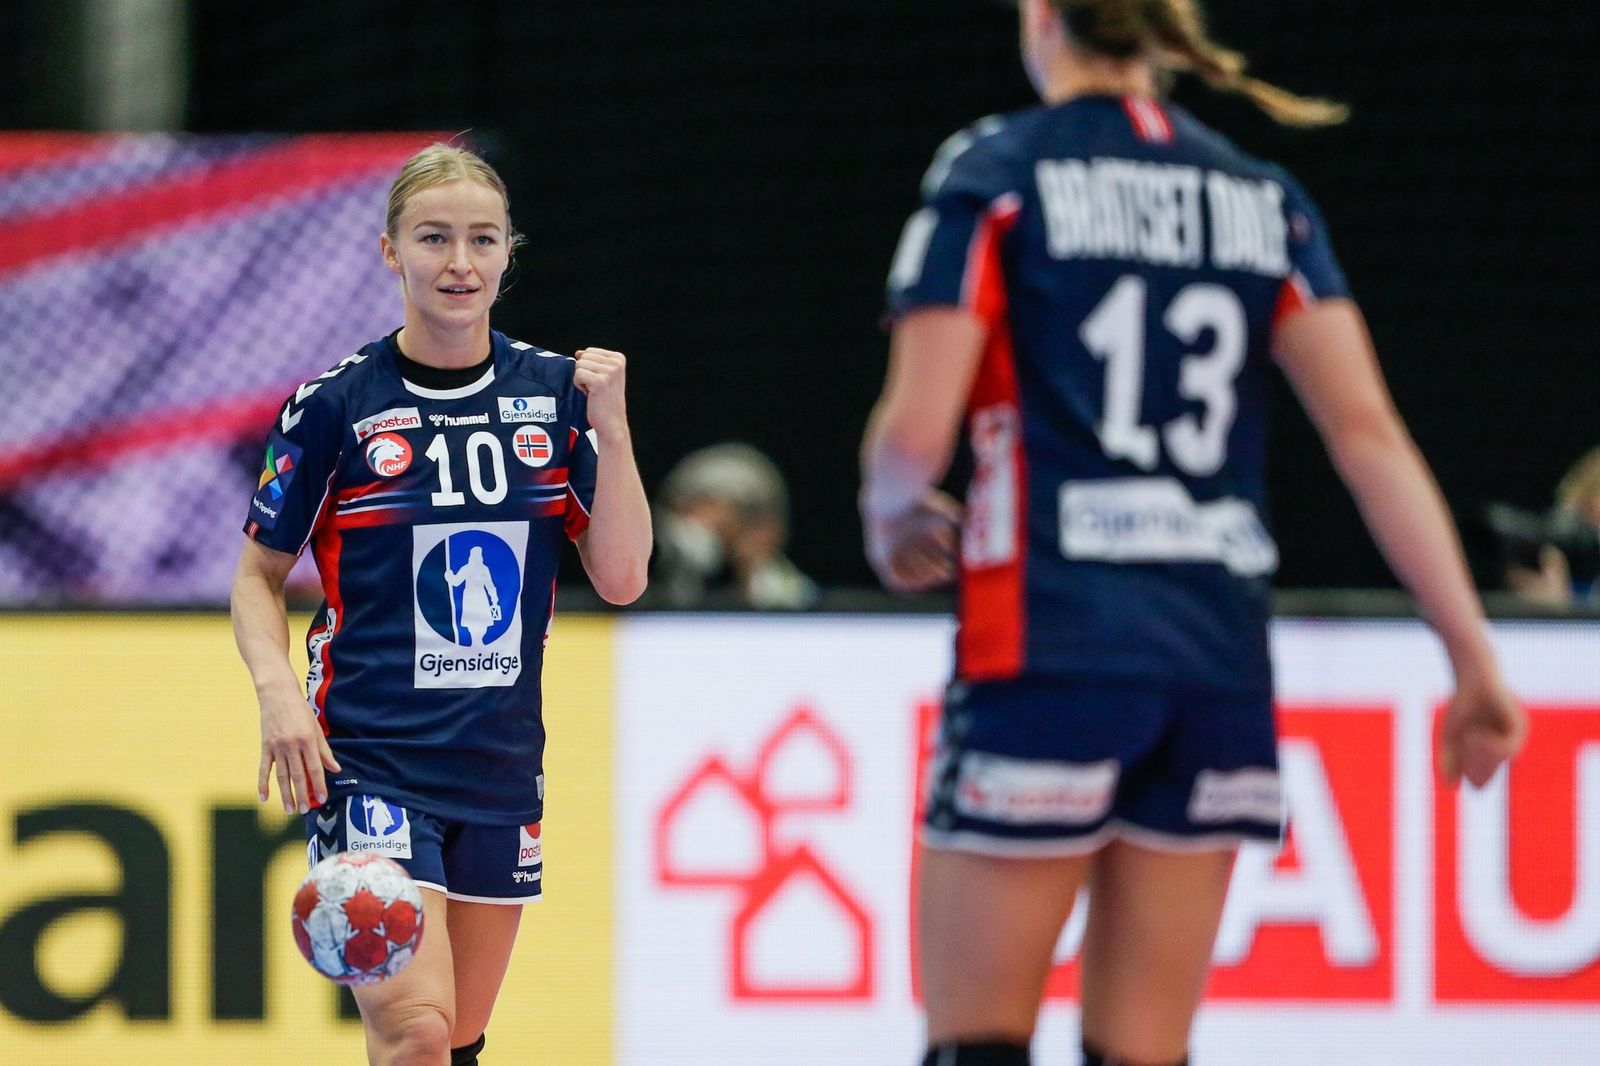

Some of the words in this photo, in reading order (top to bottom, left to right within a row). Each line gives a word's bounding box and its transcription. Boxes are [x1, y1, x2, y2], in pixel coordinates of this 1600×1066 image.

[1079, 275, 1248, 476] 13
[444, 412, 490, 427] hummel
[501, 409, 557, 422] Gjensidige
[372, 416, 419, 433] posten
[385, 460, 408, 473] NHF
[424, 431, 509, 507] 10
[419, 652, 519, 677] Gjensidige
[350, 839, 408, 852] Gjensidige
